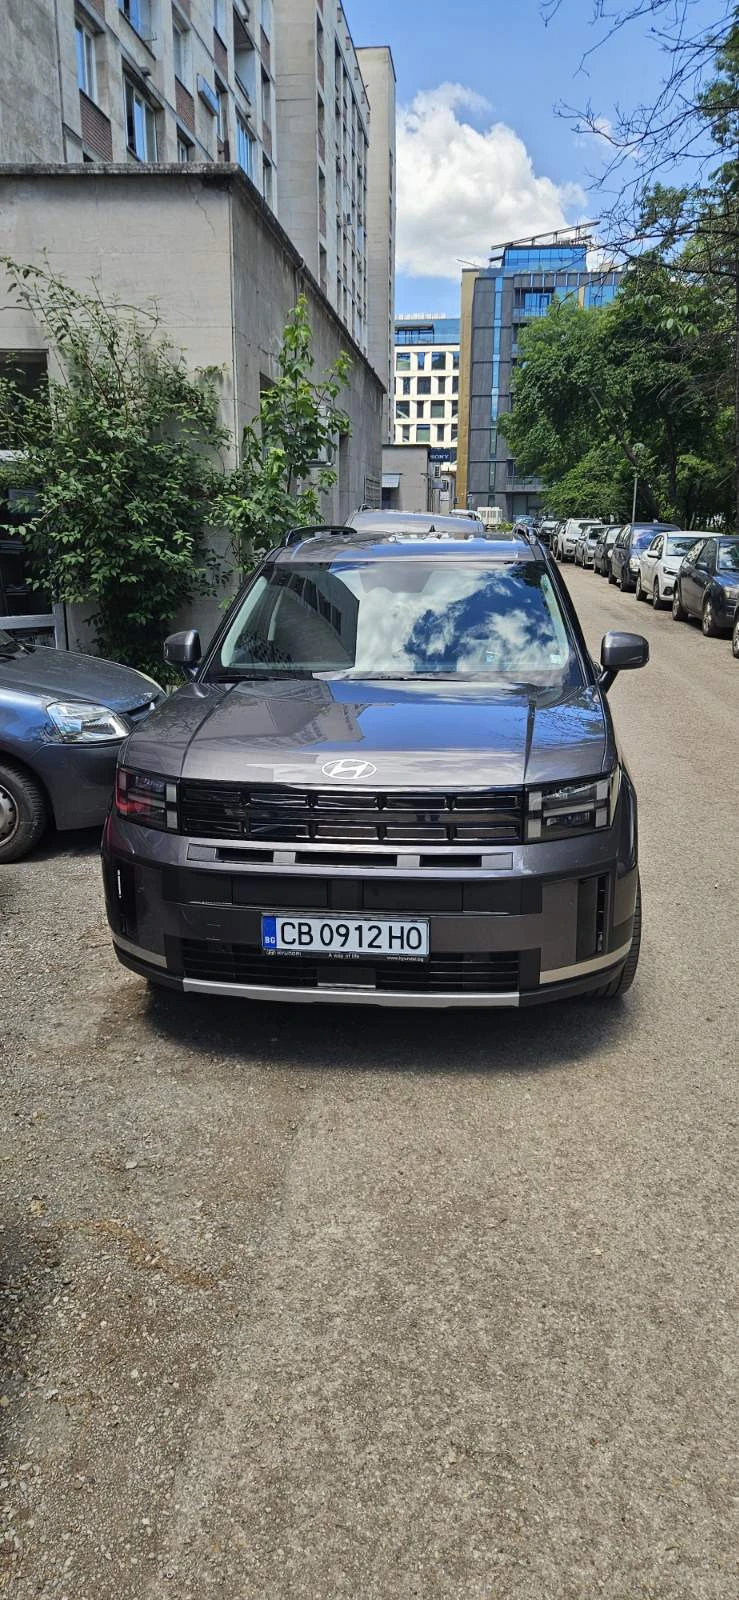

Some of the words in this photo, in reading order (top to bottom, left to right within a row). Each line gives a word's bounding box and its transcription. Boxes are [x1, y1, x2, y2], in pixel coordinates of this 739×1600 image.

[281, 922, 313, 945] CB
[320, 923, 382, 948] 0912
[389, 926, 422, 950] HO
